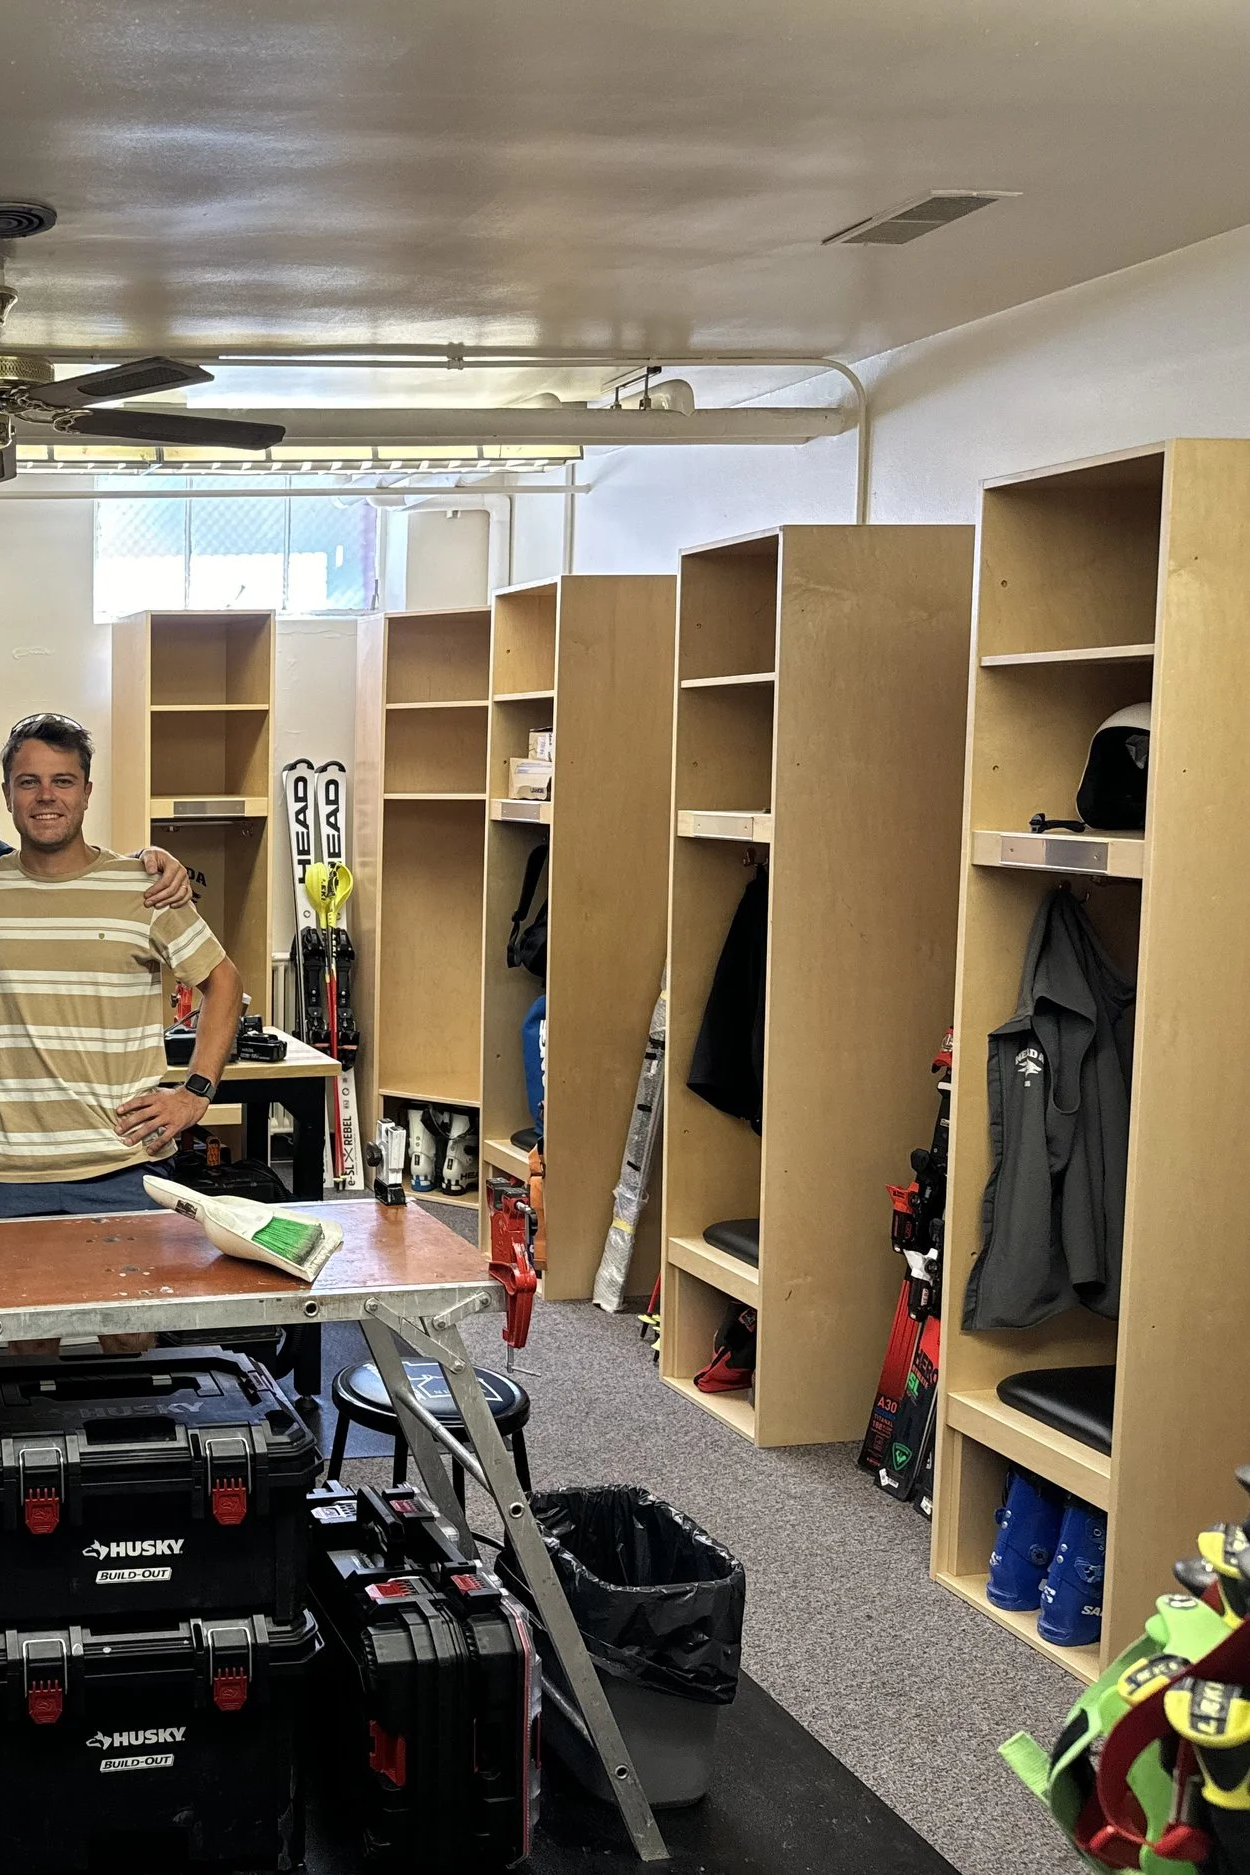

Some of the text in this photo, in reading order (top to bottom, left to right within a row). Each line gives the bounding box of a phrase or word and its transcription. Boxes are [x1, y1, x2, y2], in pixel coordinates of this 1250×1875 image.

[294, 776, 312, 884] HEAD
[325, 779, 342, 868] EAD
[342, 1115, 353, 1146] REBEL
[907, 1371, 920, 1397] SL
[877, 1396, 898, 1414] A30
[110, 1539, 184, 1558] HUSKY
[99, 1569, 169, 1581] BUILD-OUT
[113, 1726, 186, 1748] HUSKY
[103, 1755, 172, 1770] BUILD-OUT
